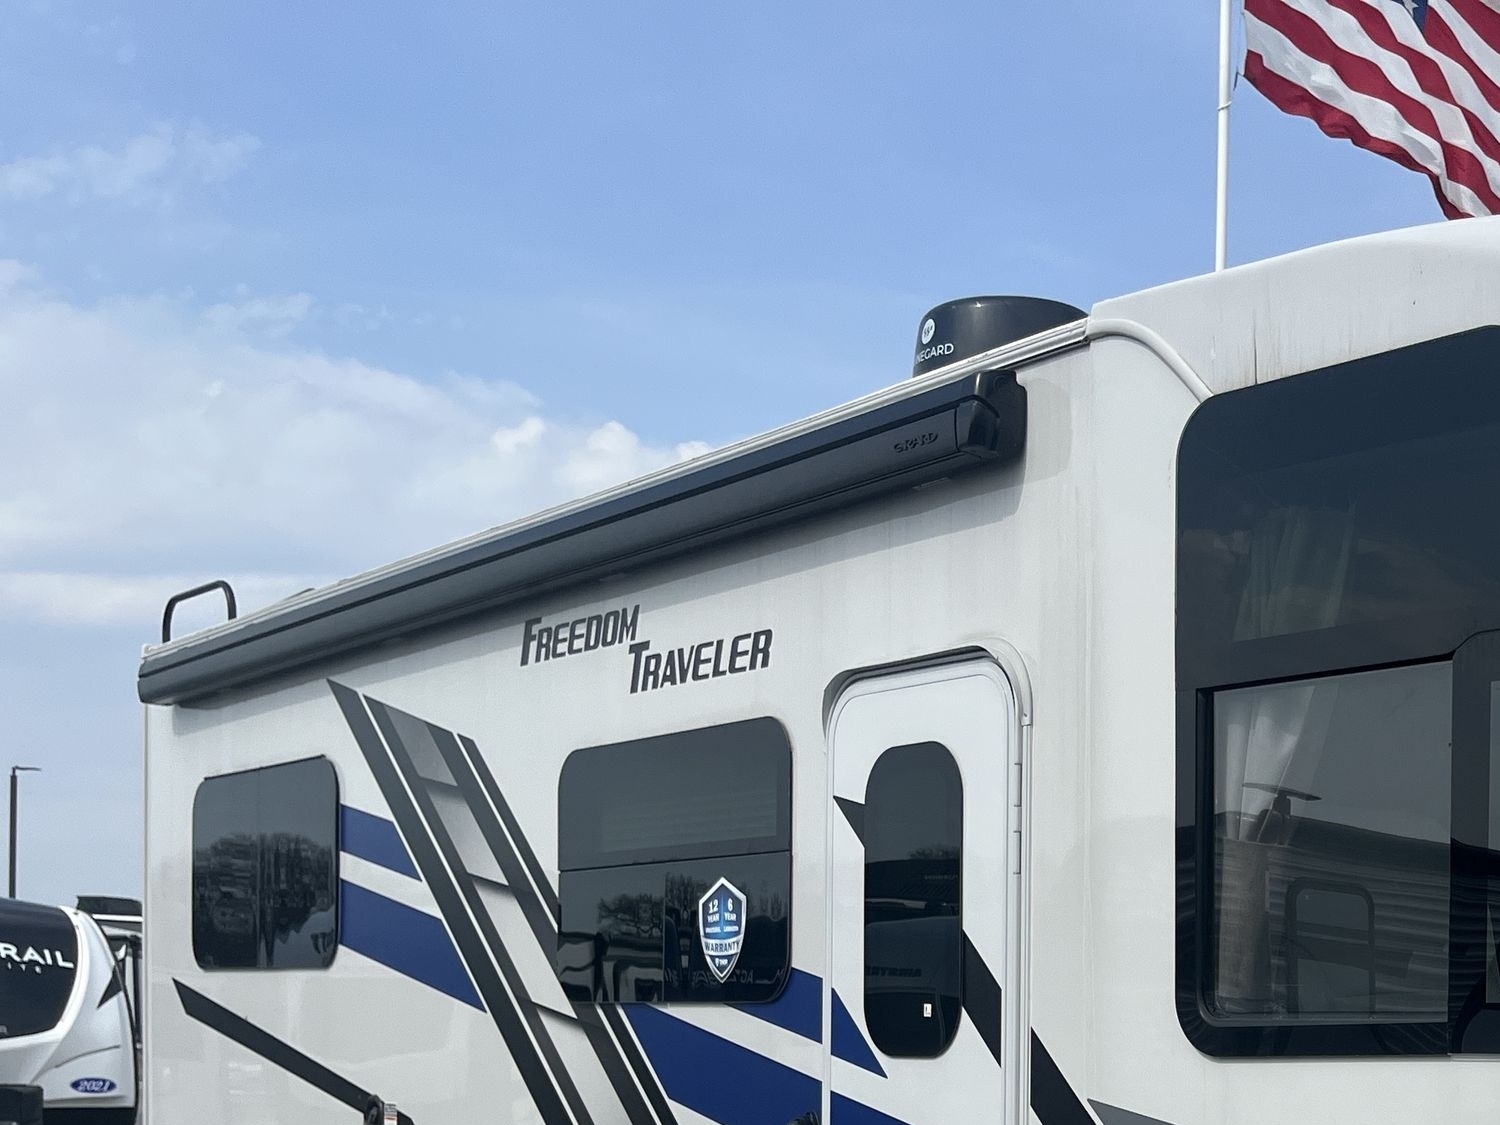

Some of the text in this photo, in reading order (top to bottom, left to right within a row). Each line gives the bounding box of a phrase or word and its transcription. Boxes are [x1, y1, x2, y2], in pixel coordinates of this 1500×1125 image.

[519, 604, 641, 667] FREEDOM
[627, 628, 774, 694] TRAVELER
[704, 941, 740, 953] WARRANTY
